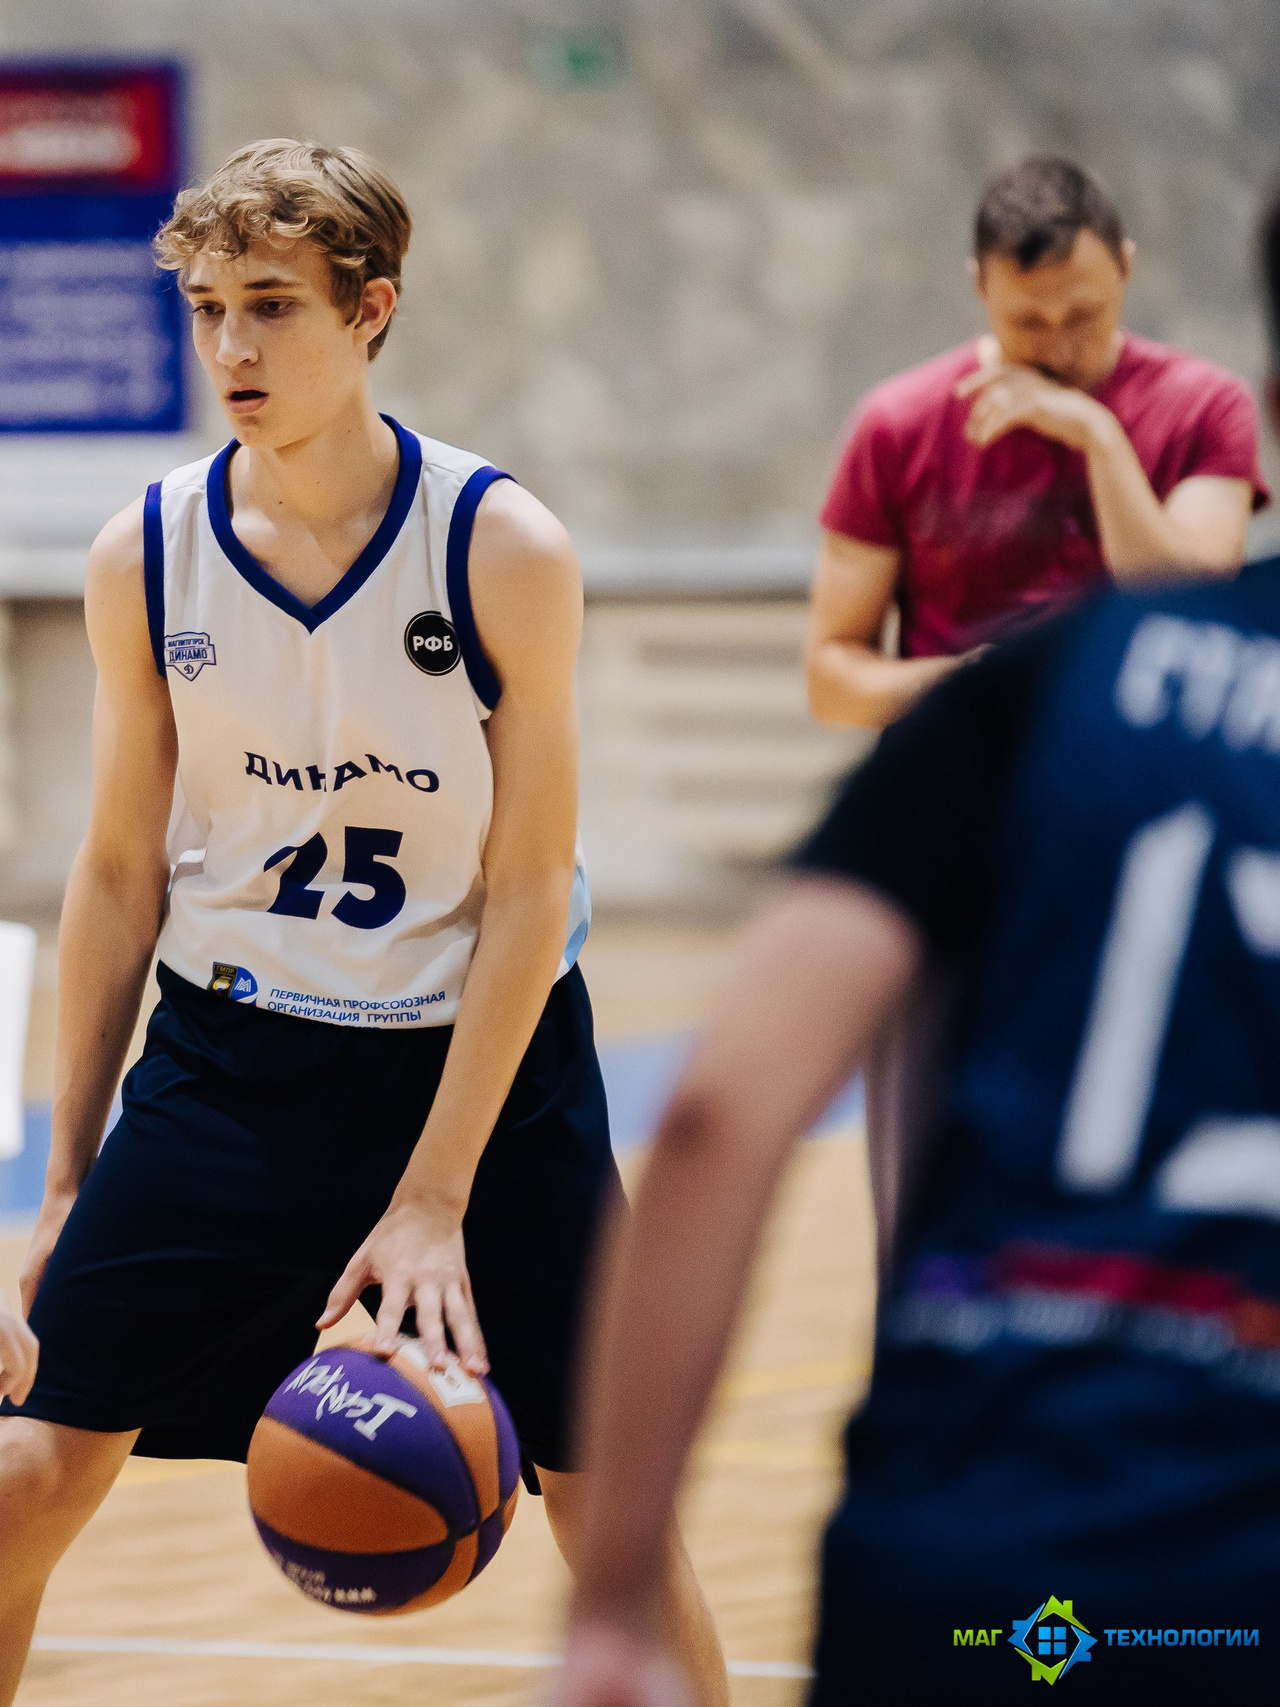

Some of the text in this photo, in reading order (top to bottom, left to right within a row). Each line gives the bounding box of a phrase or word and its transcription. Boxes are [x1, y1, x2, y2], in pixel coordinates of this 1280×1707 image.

[412, 634, 454, 653] РФБ
[169, 648, 208, 664] ДИНАМО
[243, 751, 440, 793] ДИНАМО
[263, 825, 407, 930] 25
[270, 988, 447, 1011] ПЕРВИЧНАЯ ПРОФСОЮЗНАЯ
[267, 1001, 422, 1023] ОРГАНИЗАЦИЯ ГРУППЫ
